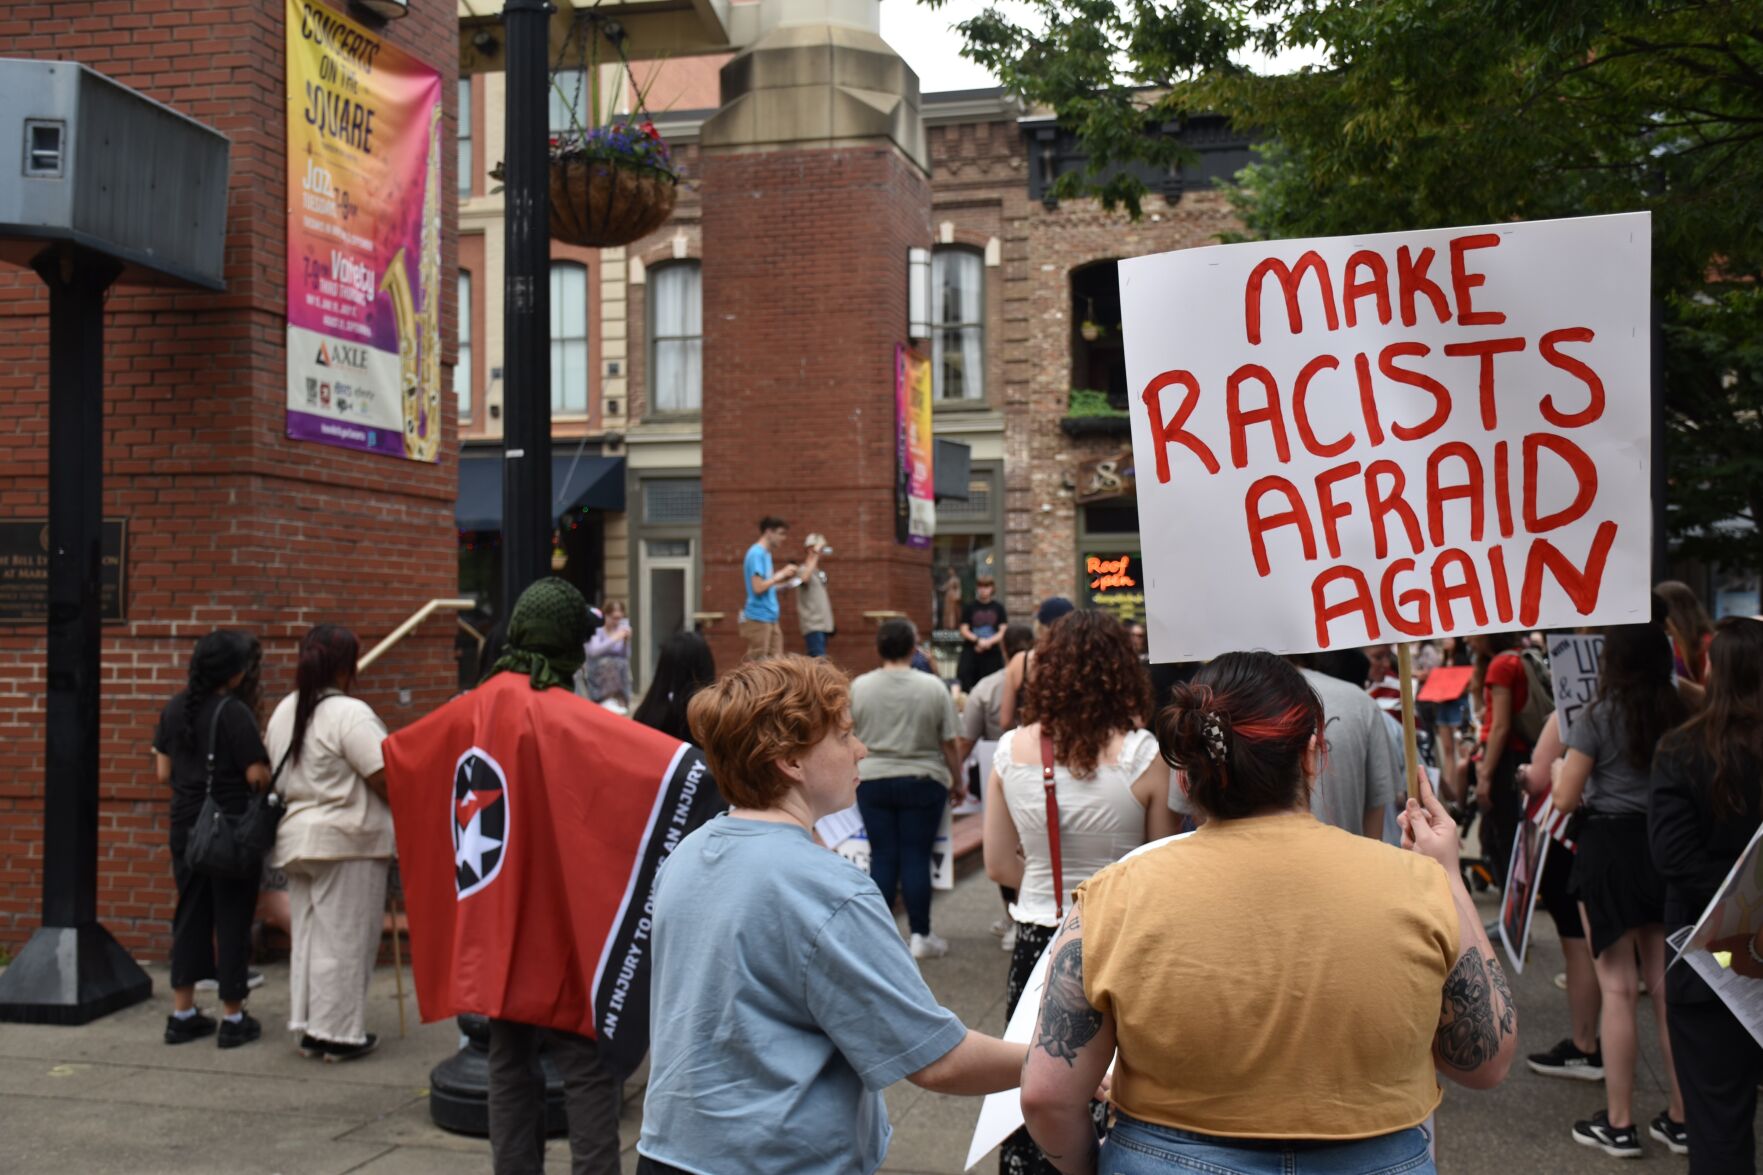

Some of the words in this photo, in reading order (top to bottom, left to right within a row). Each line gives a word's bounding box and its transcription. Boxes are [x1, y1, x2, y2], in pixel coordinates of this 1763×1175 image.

[302, 3, 380, 74] CONCERTS
[319, 55, 338, 84] ON
[305, 80, 375, 154] SQUARE
[1246, 234, 1507, 345] MAKE
[332, 344, 369, 369] AXLE
[1142, 328, 1606, 484] RACISTS
[1246, 432, 1598, 577] AFRAID
[1312, 521, 1618, 651] AGAIN
[1559, 676, 1572, 700] &
[672, 759, 707, 826] INJURY
[663, 827, 682, 854] AN
[634, 917, 652, 940] TO
[609, 942, 643, 1012] INJURY
[603, 1012, 619, 1040] AN
